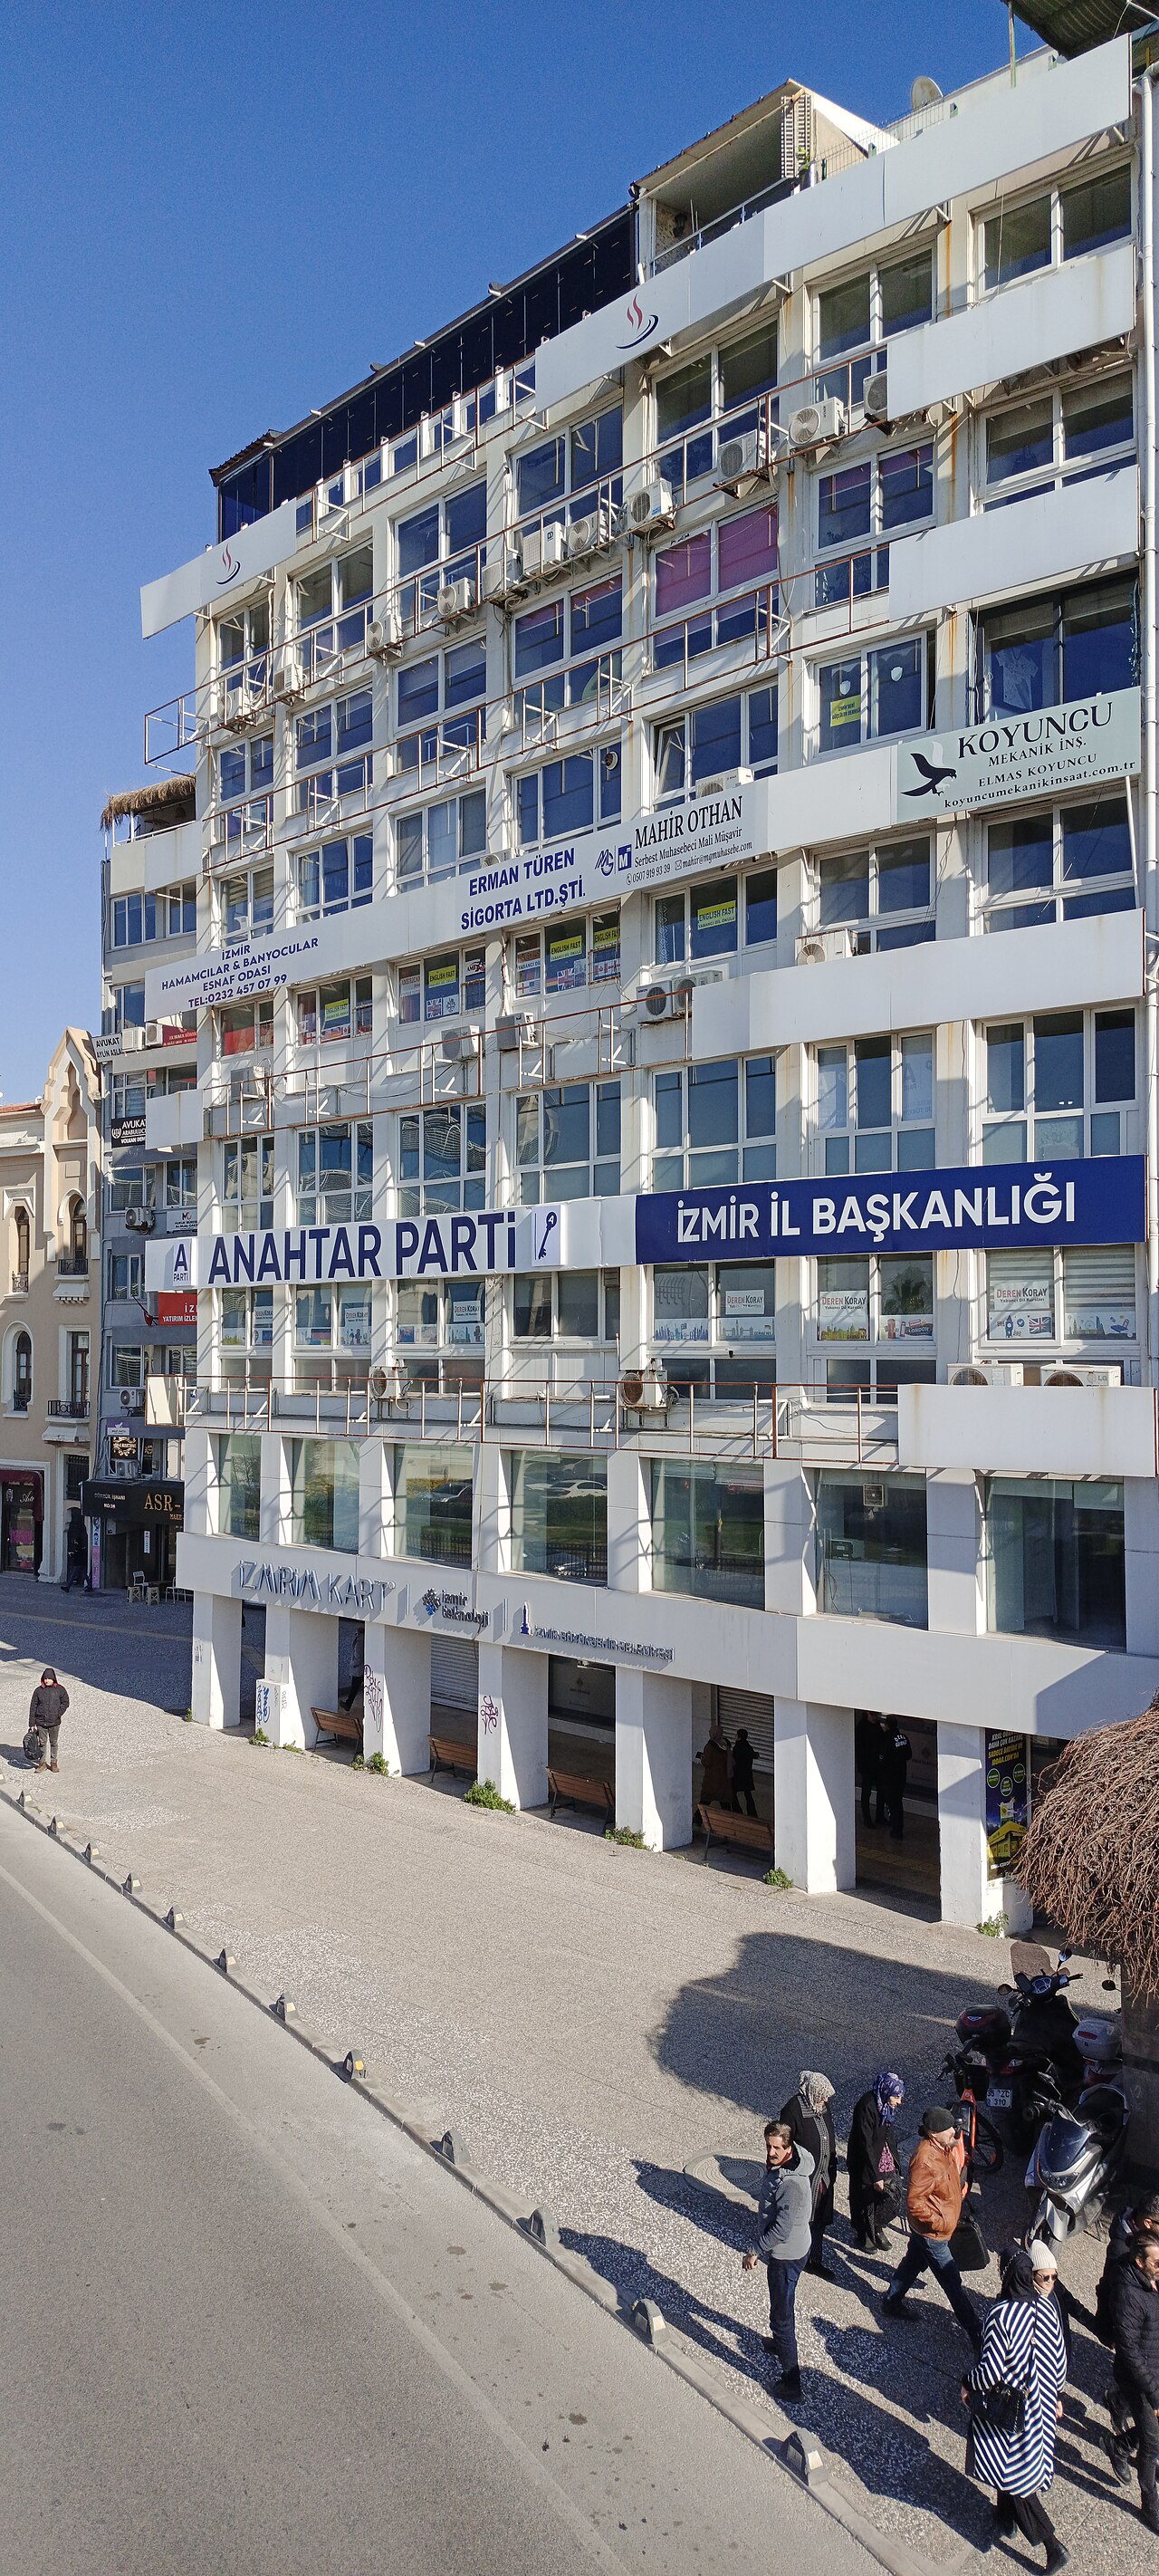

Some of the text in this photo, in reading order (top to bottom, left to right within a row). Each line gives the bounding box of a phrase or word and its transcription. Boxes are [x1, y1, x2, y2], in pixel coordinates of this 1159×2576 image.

[958, 702, 1113, 759] KOYUNCU
[988, 735, 1087, 766] MEKANİK İNŞ.
[944, 761, 1135, 808] koyuncumekanikinsaat.com.tr
[979, 754, 1097, 788] ELMAS KOYUNCU
[636, 795, 742, 851] MAHİR OTHAN
[633, 841, 753, 884] 0507 919 93 39 mahir@mgmuhasebe.com
[635, 827, 742, 868] Serbest Muhasebeci Mali Müşavir
[469, 847, 575, 897] ERMAN TÜREN
[461, 875, 586, 930] SİGORTA LTD.ŞTİ.
[699, 907, 734, 921] ENGLISH FAST
[161, 937, 319, 991] HAMAMCILAR & BANYOCULAR
[222, 944, 251, 961] İZMİR
[551, 941, 581, 955] ENGLISH FAST
[188, 974, 287, 1008] TEL:0232 457 07 99
[203, 966, 271, 992] ESNAF ODASI
[430, 970, 455, 982] ENGLISH FAST
[96, 1037, 120, 1048] AVUKAT
[676, 1173, 1076, 1243] İZMİR İL BAŞKANLIĞI
[174, 1244, 187, 1272] A
[208, 1225, 381, 1284] ANAHTAR
[185, 1303, 197, 1312] İZ
[727, 1295, 762, 1304] DEREN KORAY
[822, 1295, 867, 1305] DEREN KORAY
[997, 1287, 1048, 1298] DEREN KORAY
[327, 1572, 388, 1611] KART
[442, 1590, 490, 1628] izmir teknoloji
